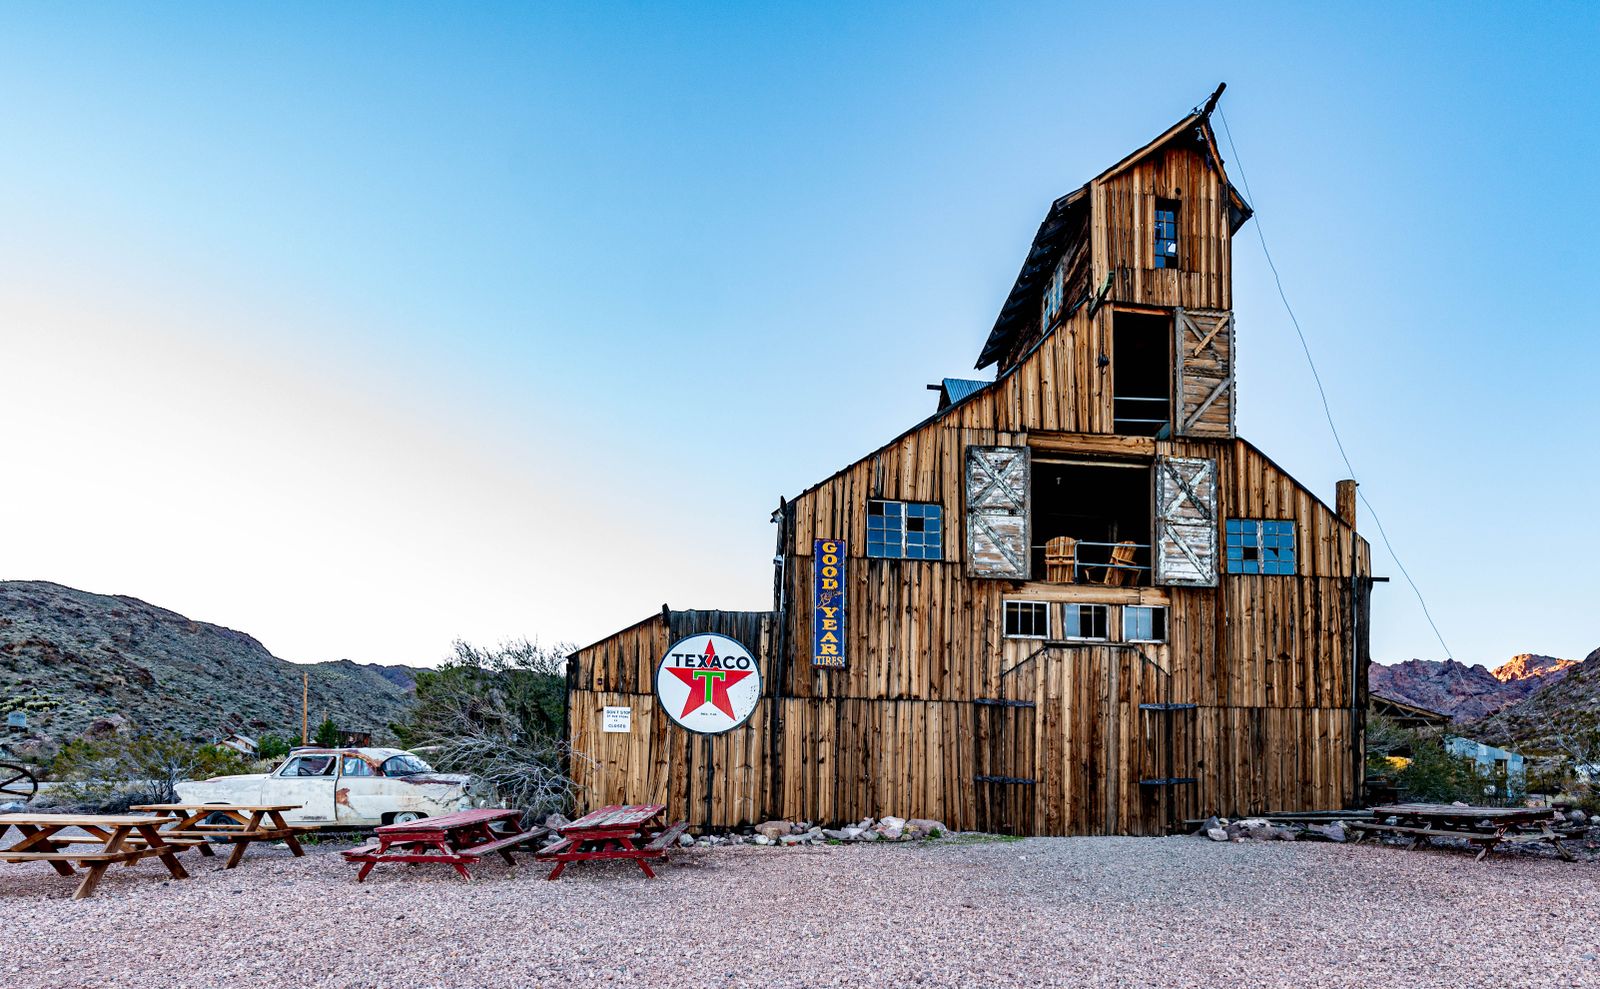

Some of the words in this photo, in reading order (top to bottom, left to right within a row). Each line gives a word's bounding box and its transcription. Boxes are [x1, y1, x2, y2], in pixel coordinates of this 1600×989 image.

[822, 542, 838, 590] GOOD
[820, 606, 839, 655] YEAR
[672, 653, 750, 669] TEXACO
[816, 656, 843, 666] TIRES
[693, 671, 726, 703] T
